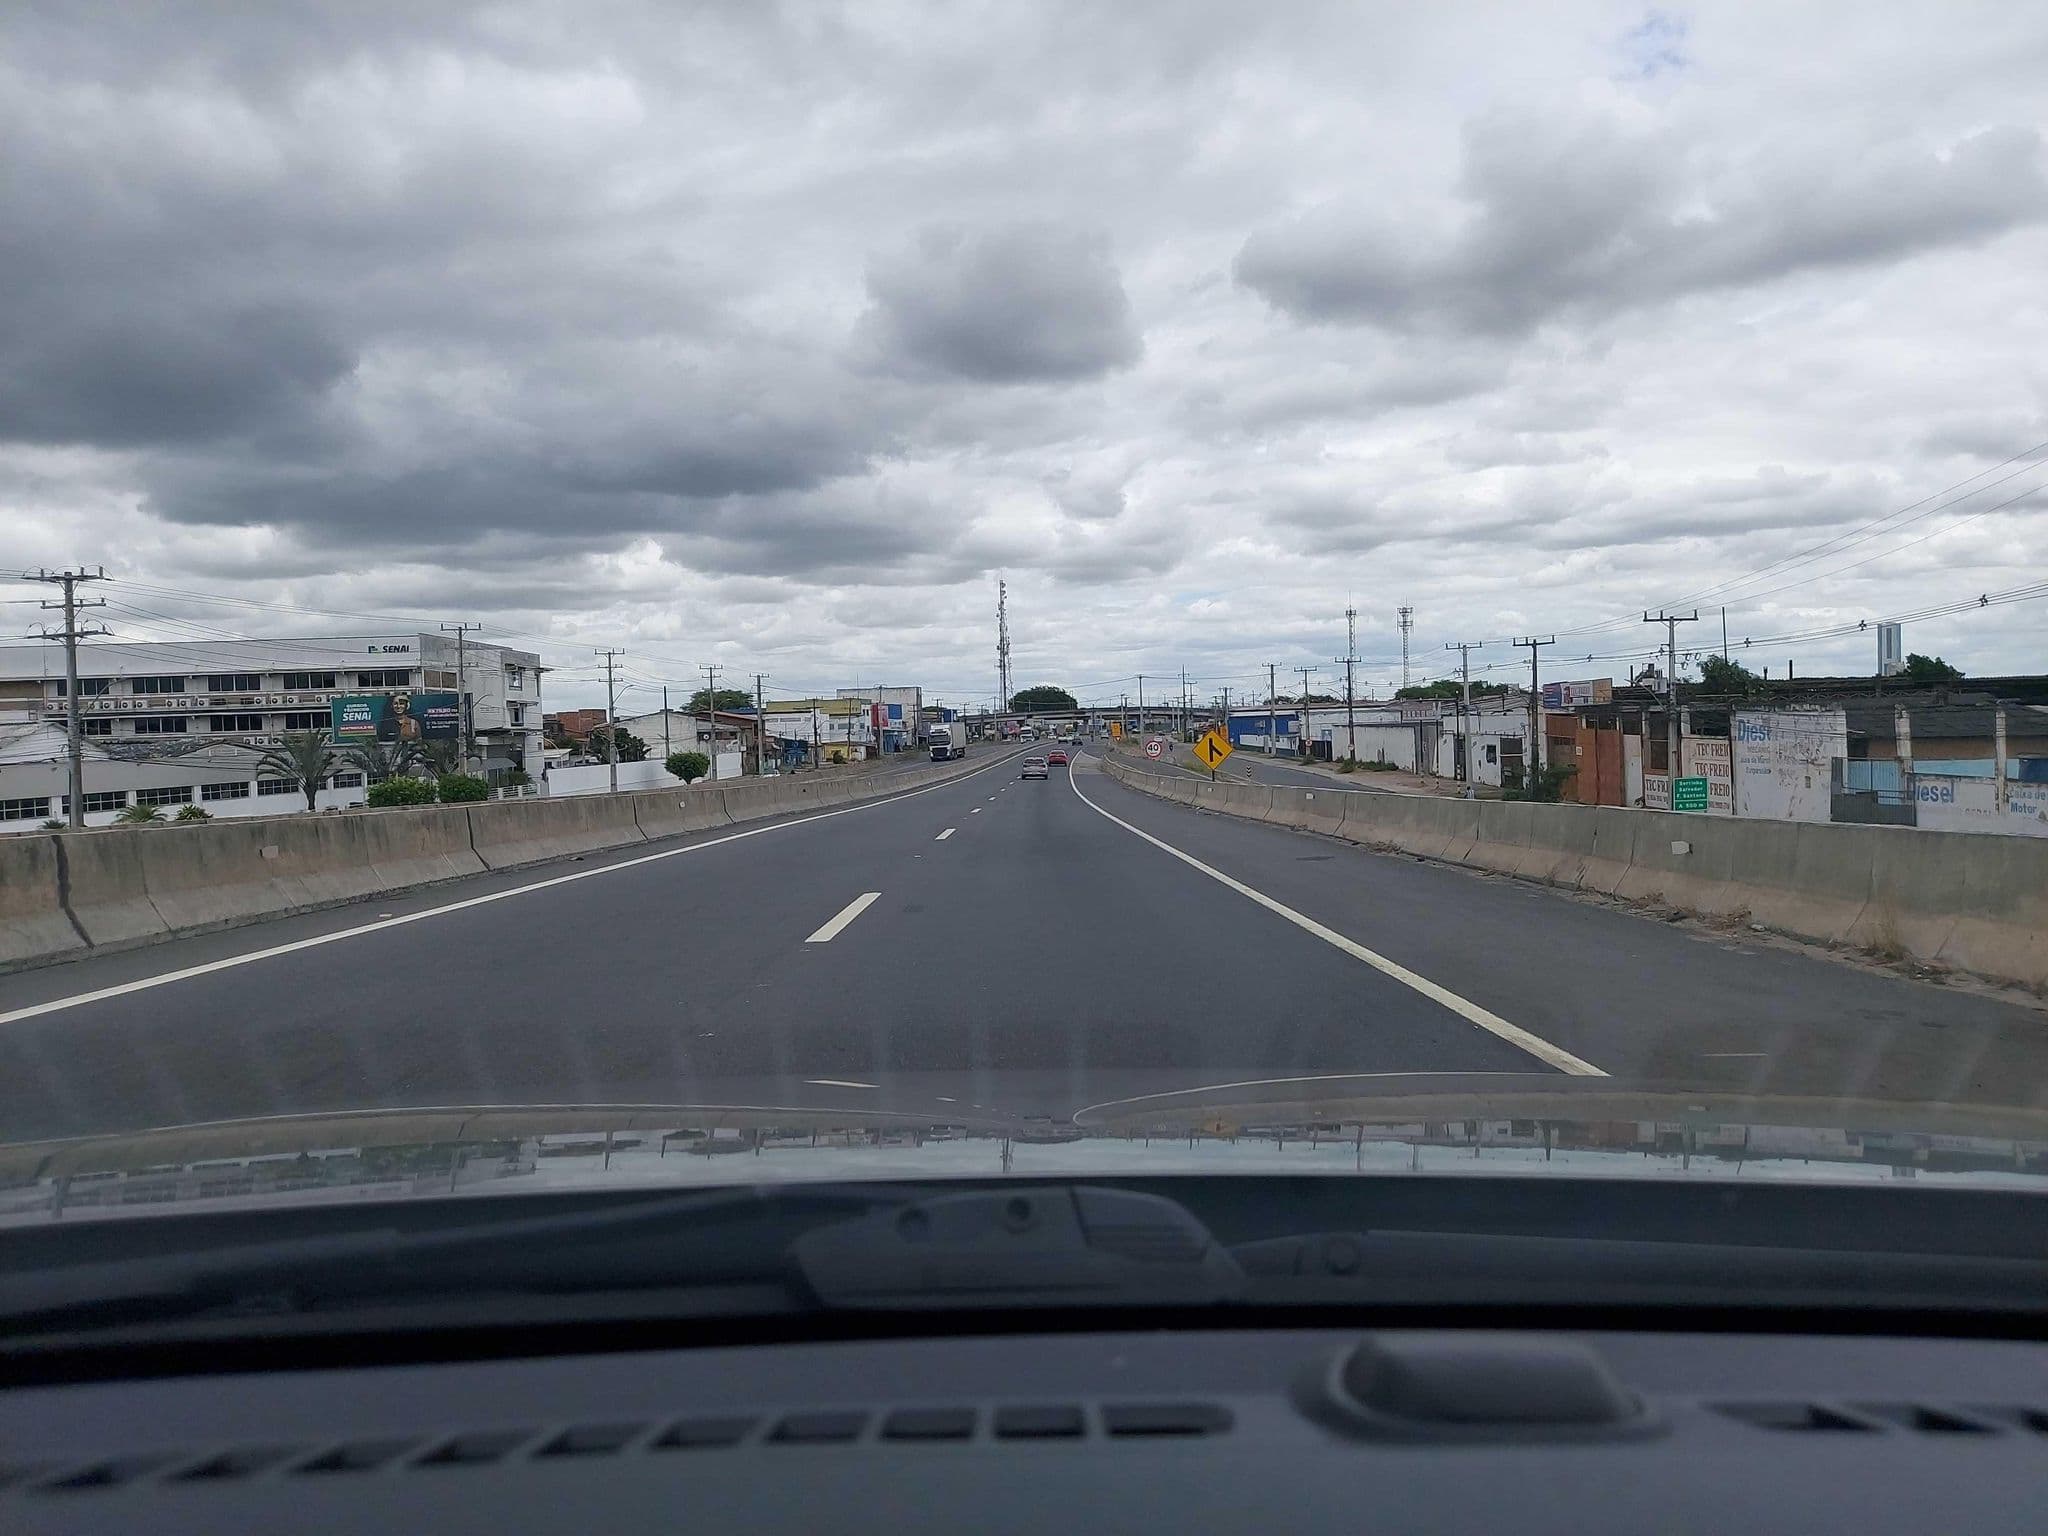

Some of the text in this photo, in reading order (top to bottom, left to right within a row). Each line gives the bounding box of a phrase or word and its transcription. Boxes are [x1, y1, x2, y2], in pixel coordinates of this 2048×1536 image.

[382, 644, 409, 653] SENAI
[1147, 743, 1159, 751] 40
[1696, 743, 1710, 756] TEC
[1695, 762, 1730, 778] TEC FREIO
[1710, 782, 1730, 797] FREIO
[1917, 781, 1955, 803] iesel
[2010, 801, 2038, 814] Motor
